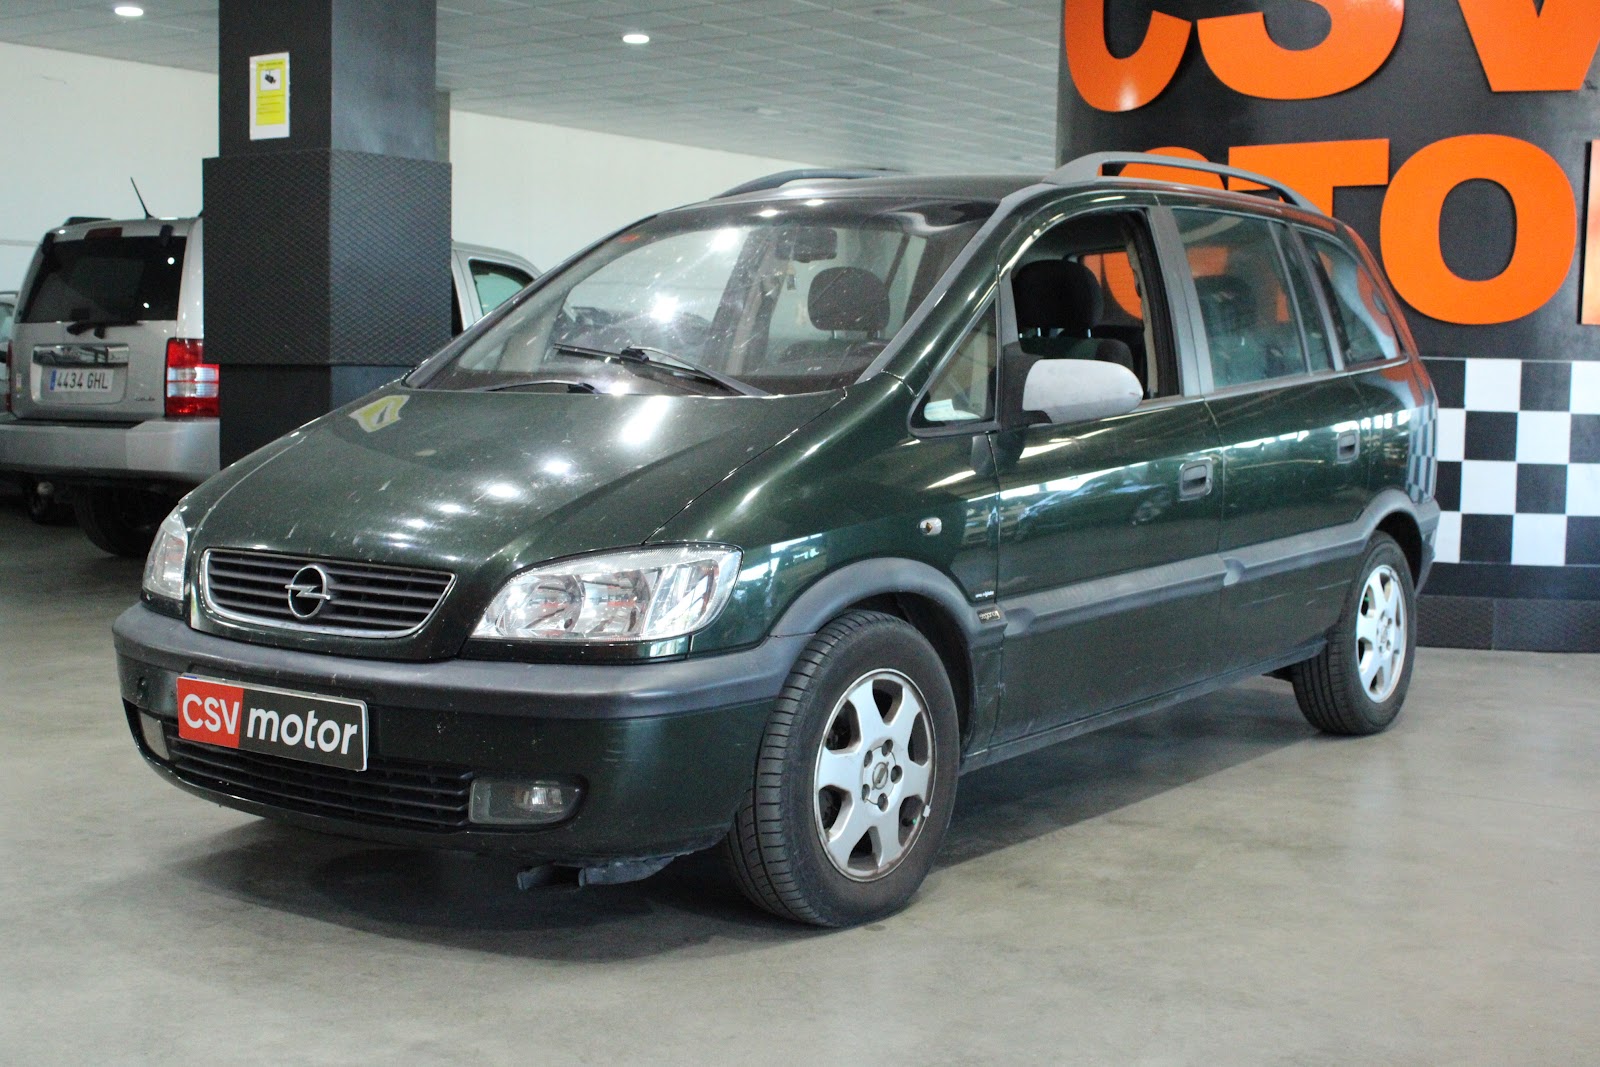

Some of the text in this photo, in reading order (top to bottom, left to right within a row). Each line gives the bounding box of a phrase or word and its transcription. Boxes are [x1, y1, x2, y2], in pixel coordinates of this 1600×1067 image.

[57, 372, 108, 389] 4434 GHL
[182, 693, 358, 755] CSV motor
